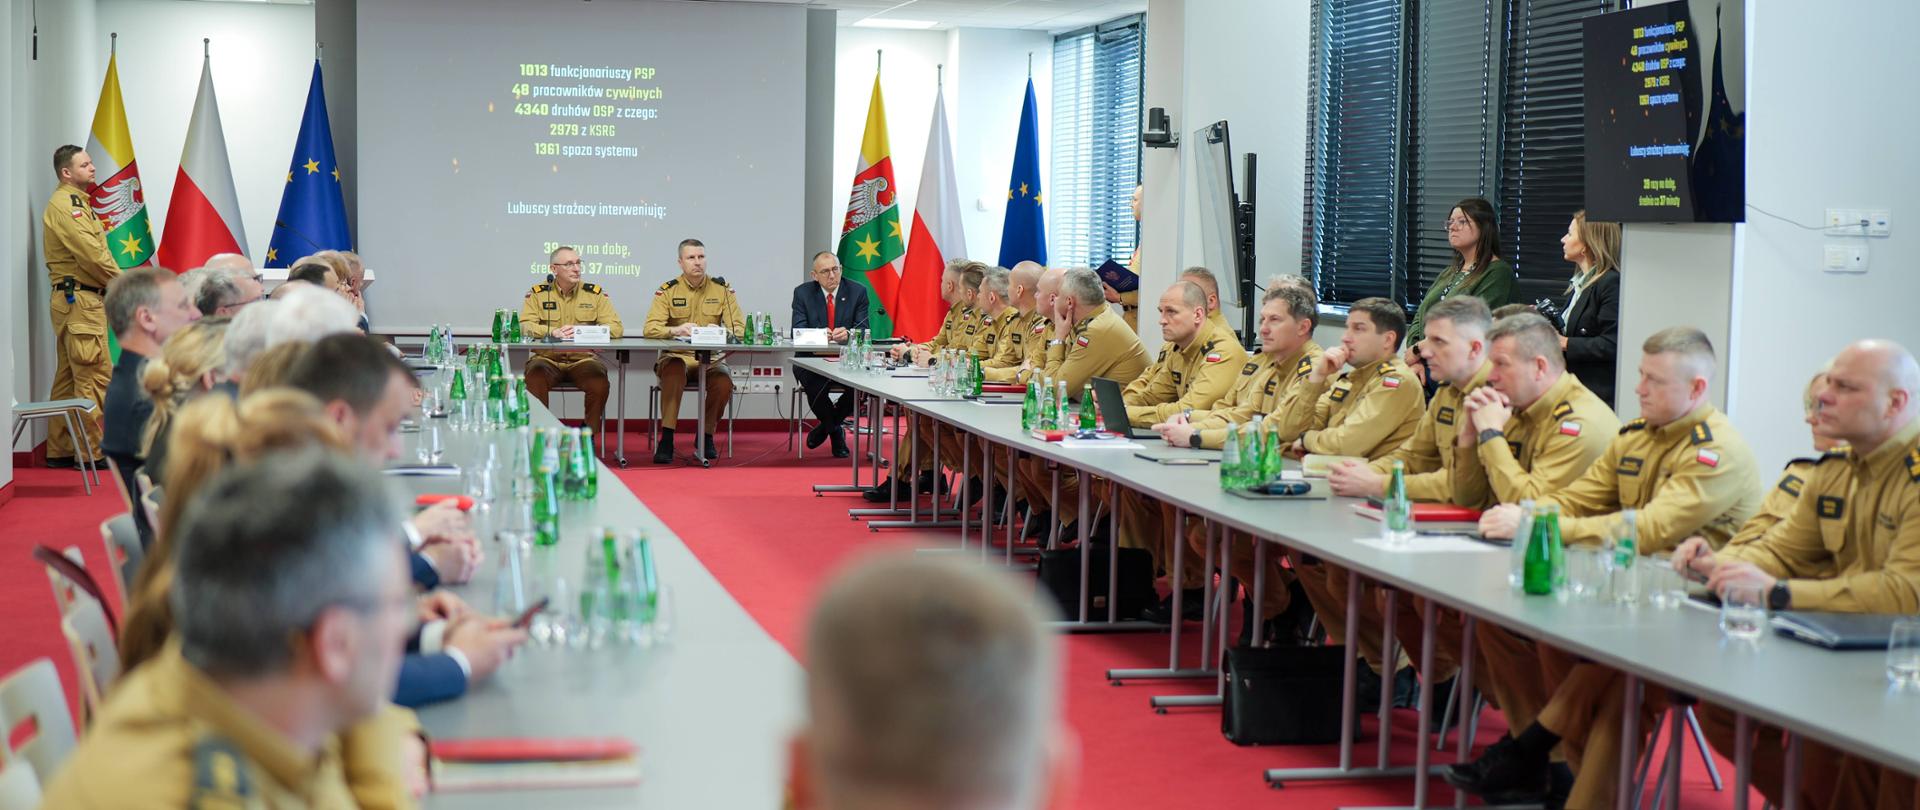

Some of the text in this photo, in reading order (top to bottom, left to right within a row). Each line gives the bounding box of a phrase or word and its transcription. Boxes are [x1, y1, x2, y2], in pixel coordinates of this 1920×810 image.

[520, 64, 656, 81] 1013 funkcjonariuszy PSP
[512, 83, 662, 100] 48 pracowników cywilnych
[514, 103, 658, 120] 4340 druhów OSP z czego:
[550, 124, 615, 136] 2979 z KSRG
[534, 143, 638, 158] 1361 spoza systemu
[508, 202, 666, 220] Lubuscy strażacy interweniują:
[587, 245, 599, 255] na
[602, 242, 630, 258] dobę,
[589, 263, 602, 274] 37
[605, 263, 640, 277] minuty
